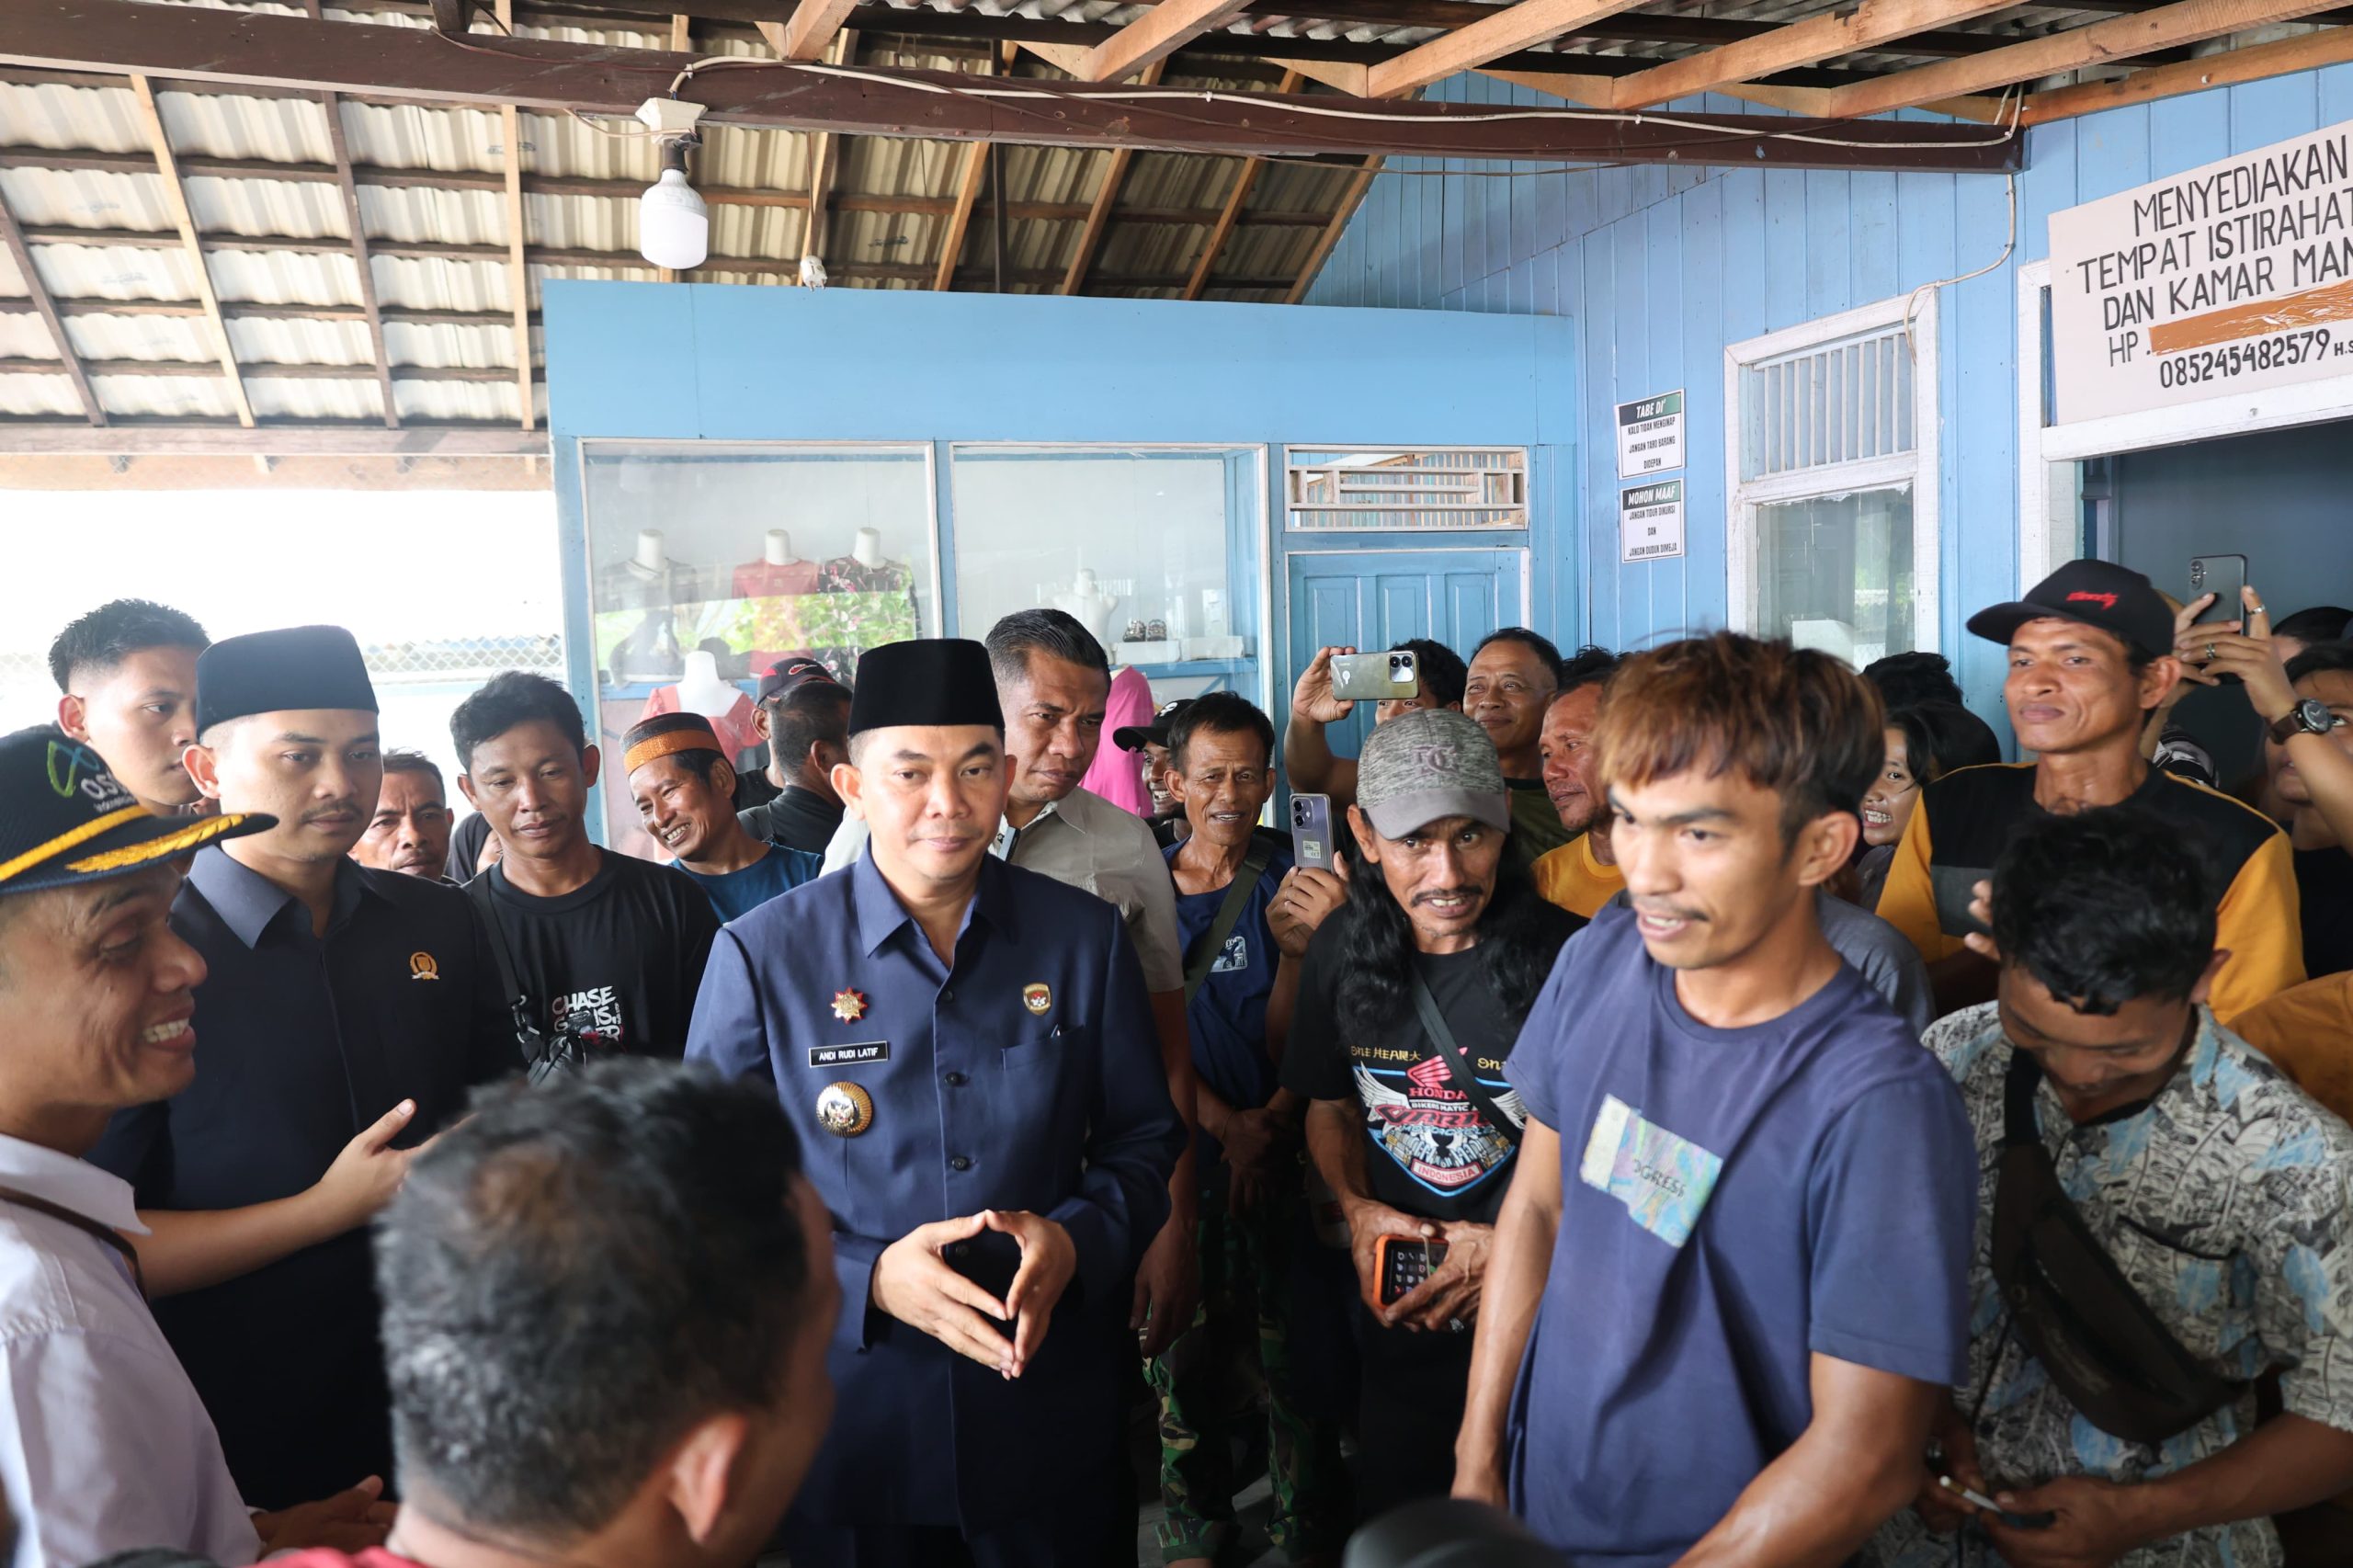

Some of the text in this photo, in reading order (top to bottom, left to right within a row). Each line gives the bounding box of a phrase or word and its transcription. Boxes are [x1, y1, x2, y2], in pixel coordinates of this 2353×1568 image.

[2134, 134, 2347, 237] MENYEDIAKAN
[2077, 231, 2196, 294] TEMPAT
[2104, 287, 2154, 330] DAN
[2169, 256, 2275, 314] KAMAR
[2160, 328, 2331, 388] 085245482579
[1636, 403, 1654, 419] TABE
[1628, 416, 1676, 436] KALO TIDAK MENGINAP
[1629, 436, 1676, 453] JANGAN TARO BARANG
[1643, 458, 1662, 469] DIDEPAN
[1628, 485, 1676, 506] MOHON MAAF
[1629, 506, 1676, 520] JANGAN TIDUR DIKURSI
[1647, 527, 1656, 536] DAN
[1629, 542, 1677, 557] JANGAN DUDUK DIMEJA
[552, 985, 617, 1015] CHASE
[819, 1047, 879, 1062] ANDI RUDI LATIF
[1408, 1087, 1468, 1099] HONDA
[1418, 1165, 1476, 1183] INDONESIA
